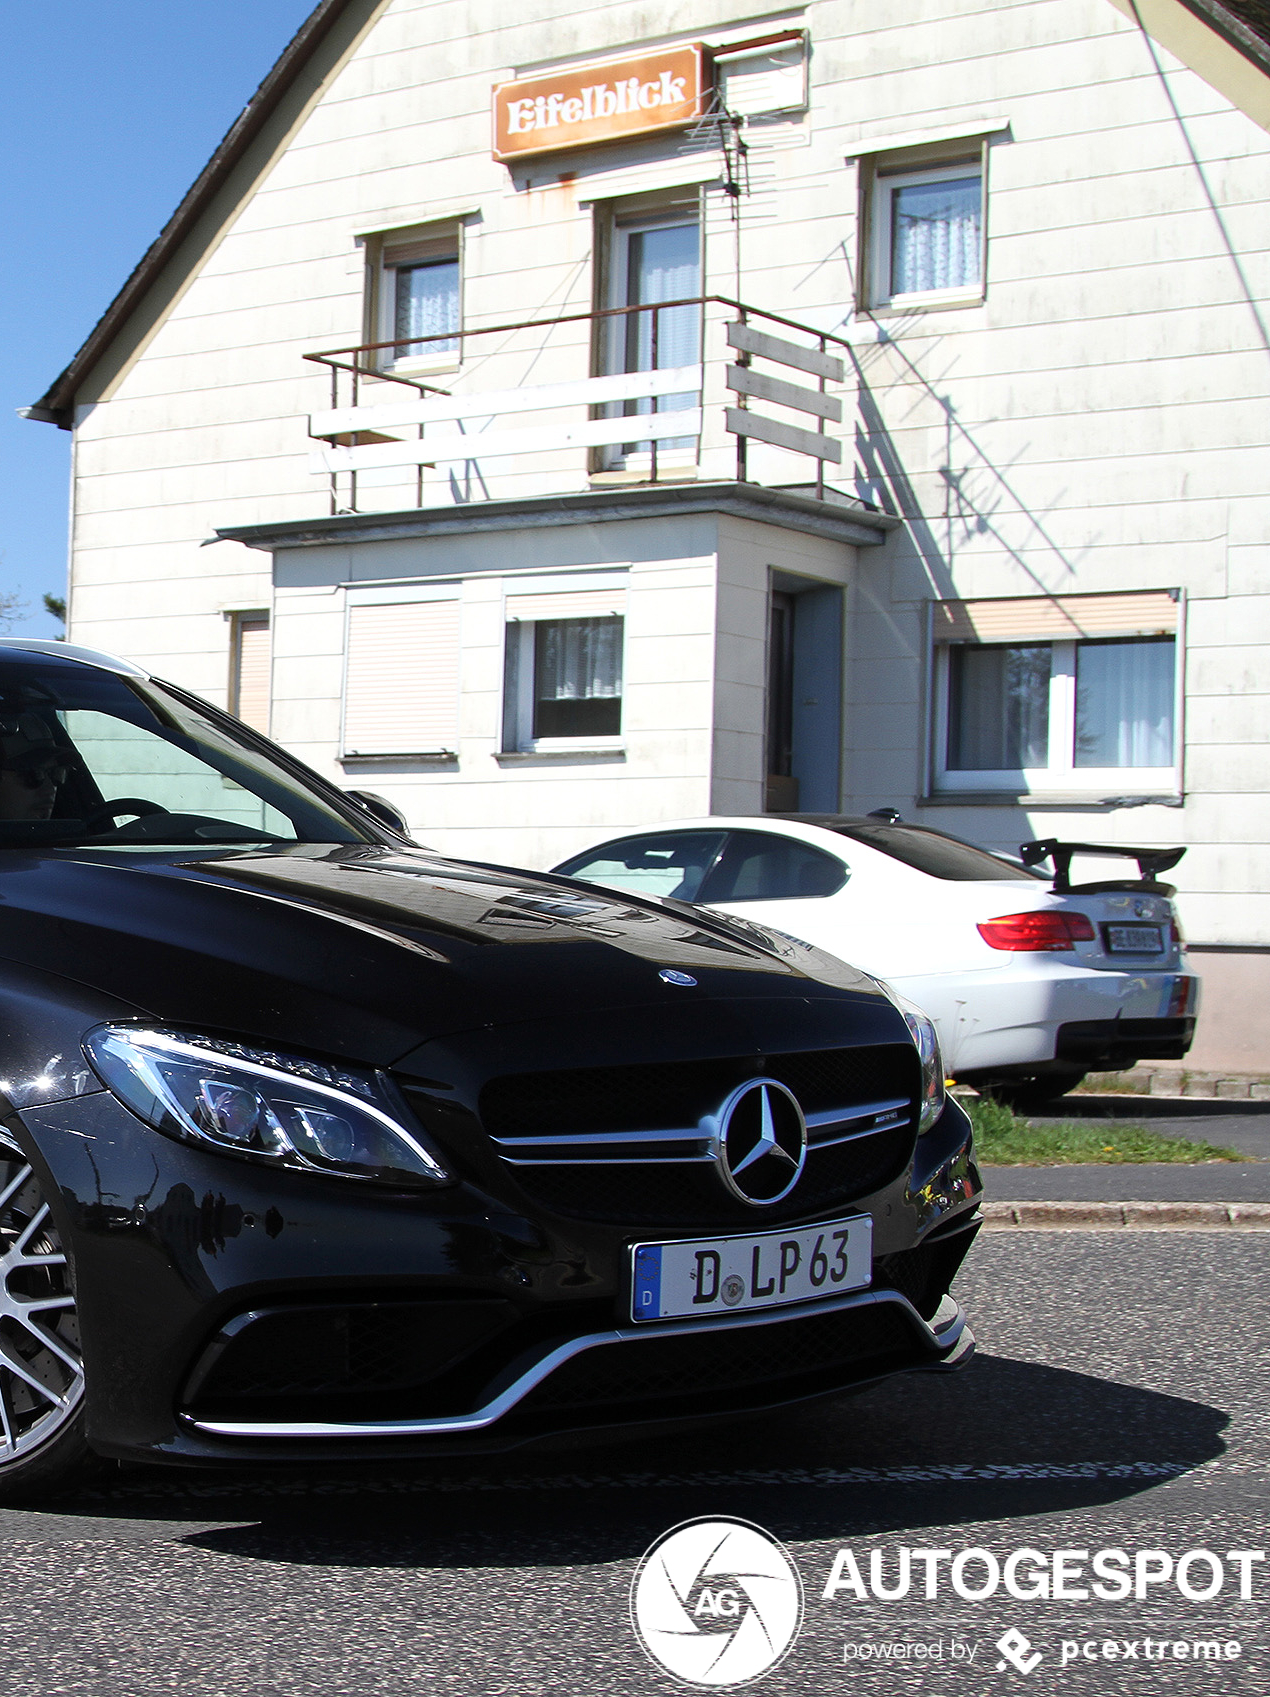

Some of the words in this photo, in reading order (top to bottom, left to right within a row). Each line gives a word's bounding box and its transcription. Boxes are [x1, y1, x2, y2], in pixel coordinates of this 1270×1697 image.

[507, 71, 686, 135] Eifelblick
[642, 1290, 653, 1306] D
[693, 1249, 721, 1304] D
